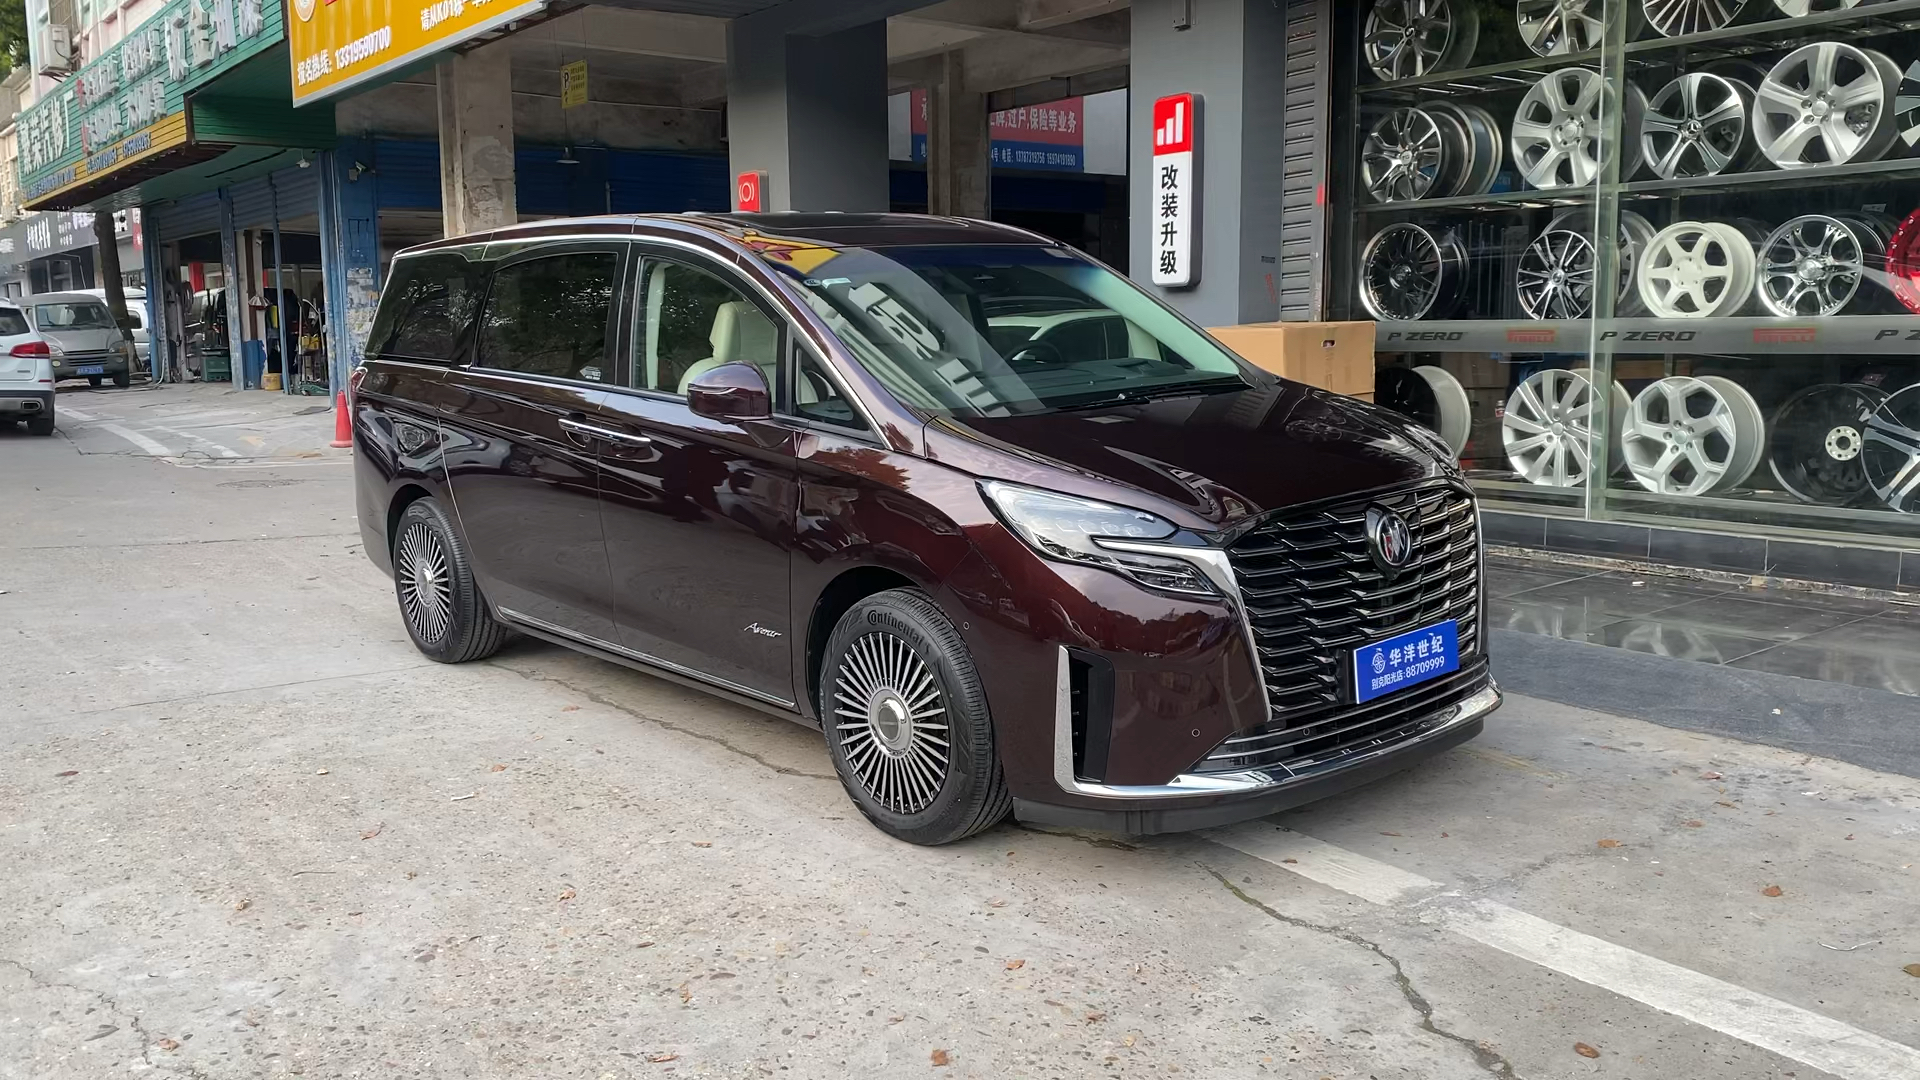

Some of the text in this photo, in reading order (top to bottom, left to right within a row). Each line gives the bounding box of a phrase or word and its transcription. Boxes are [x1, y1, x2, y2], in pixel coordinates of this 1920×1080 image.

[1160, 164, 1178, 275] 改装升级
[1387, 331, 1463, 341] P ZERO
[1600, 331, 1696, 341] P ZERO
[1874, 329, 1899, 341] P
[867, 609, 925, 646] Continental
[1389, 635, 1444, 667] 华洋世纪
